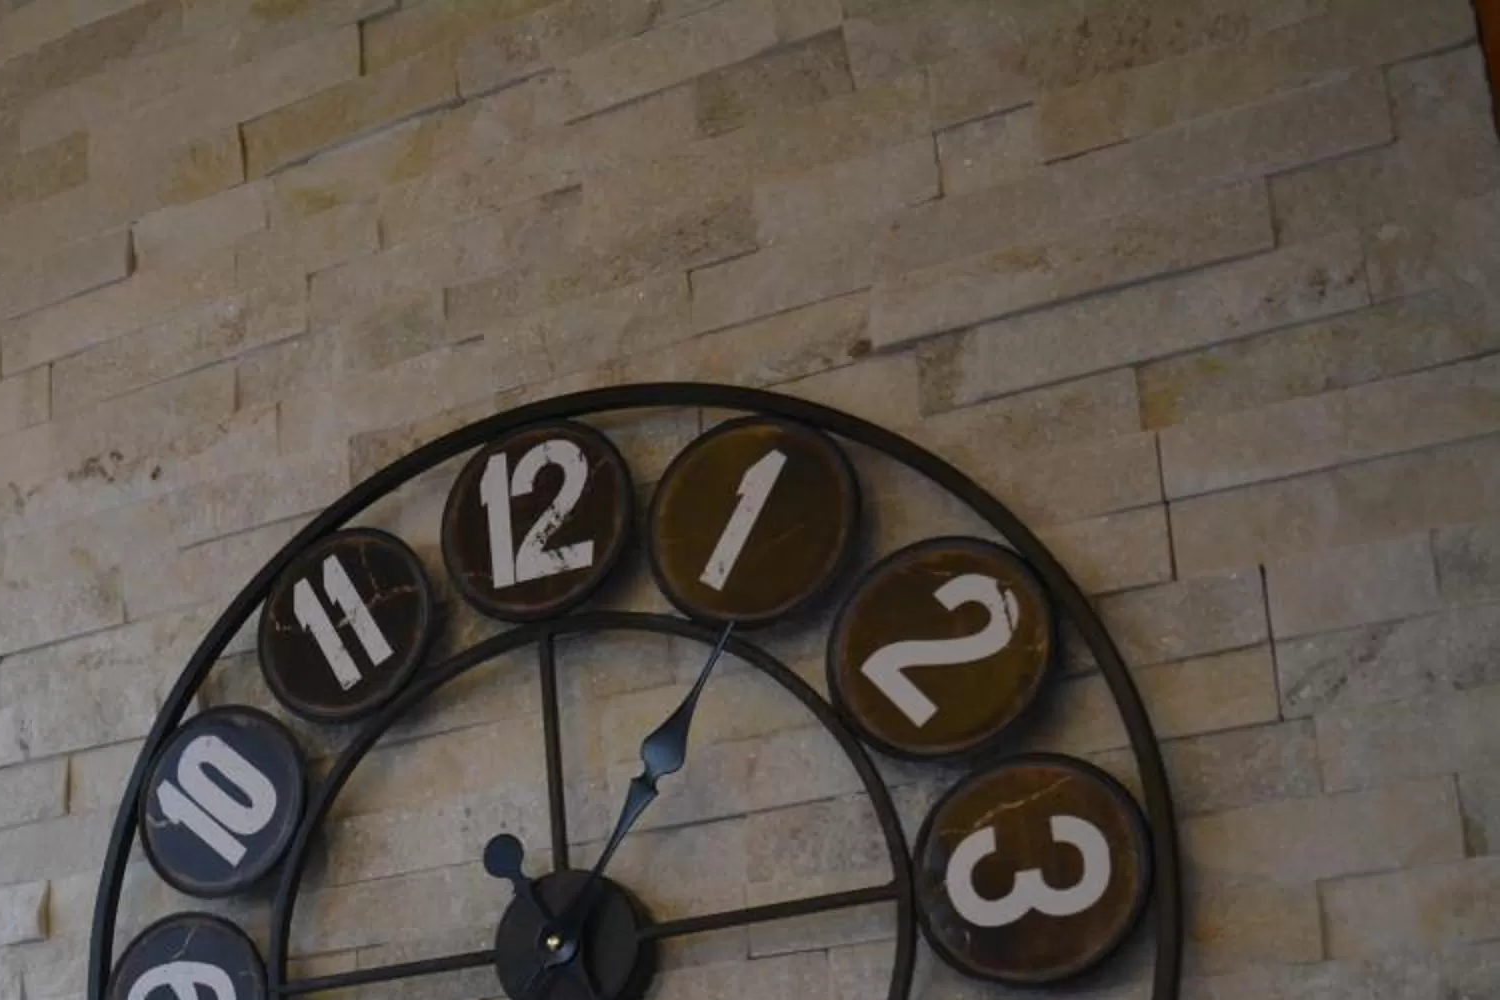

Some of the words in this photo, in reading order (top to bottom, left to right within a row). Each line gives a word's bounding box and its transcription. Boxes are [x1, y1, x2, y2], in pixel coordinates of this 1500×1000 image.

[480, 438, 594, 589] 12
[699, 449, 787, 591] 1
[293, 554, 394, 691] 11
[860, 573, 1020, 727] 2
[156, 735, 277, 867] 10
[944, 815, 1111, 927] 3
